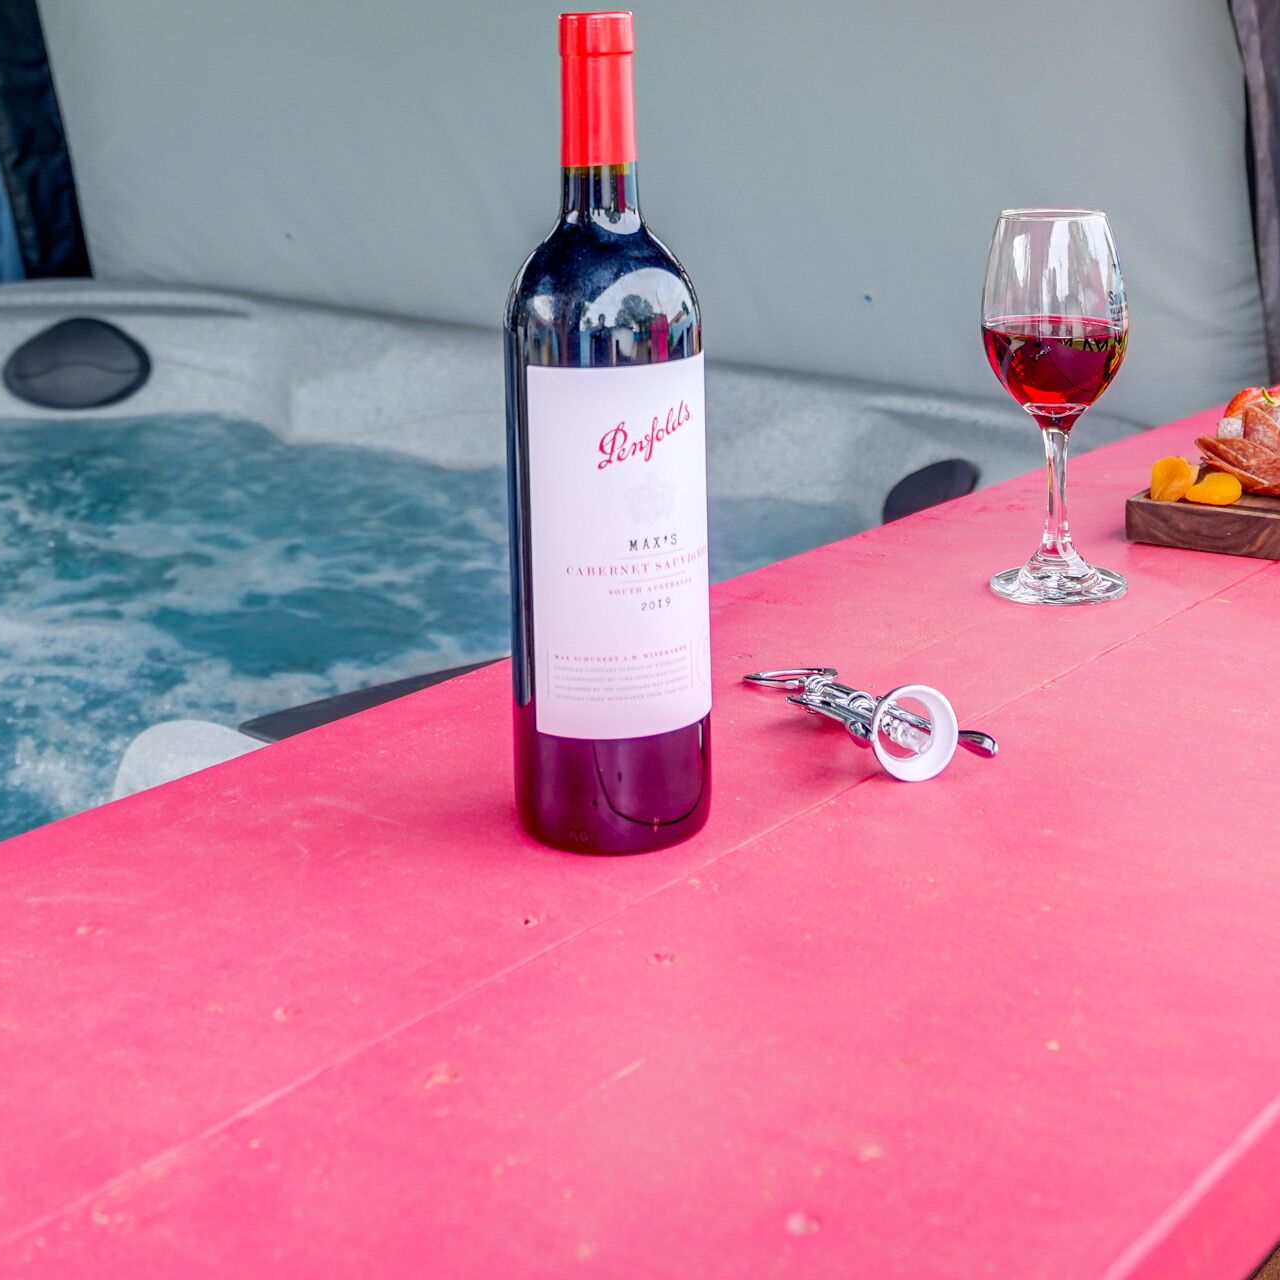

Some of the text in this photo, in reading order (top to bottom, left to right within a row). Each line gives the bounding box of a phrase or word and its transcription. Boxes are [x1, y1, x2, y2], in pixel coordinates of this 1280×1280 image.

[597, 399, 690, 470] Penfolds
[629, 533, 678, 552] MAX'S
[566, 563, 650, 577] CABERNET
[608, 577, 693, 596] SOUTH AUSTRALIA
[641, 597, 672, 612] 2019
[554, 654, 570, 662] MAX
